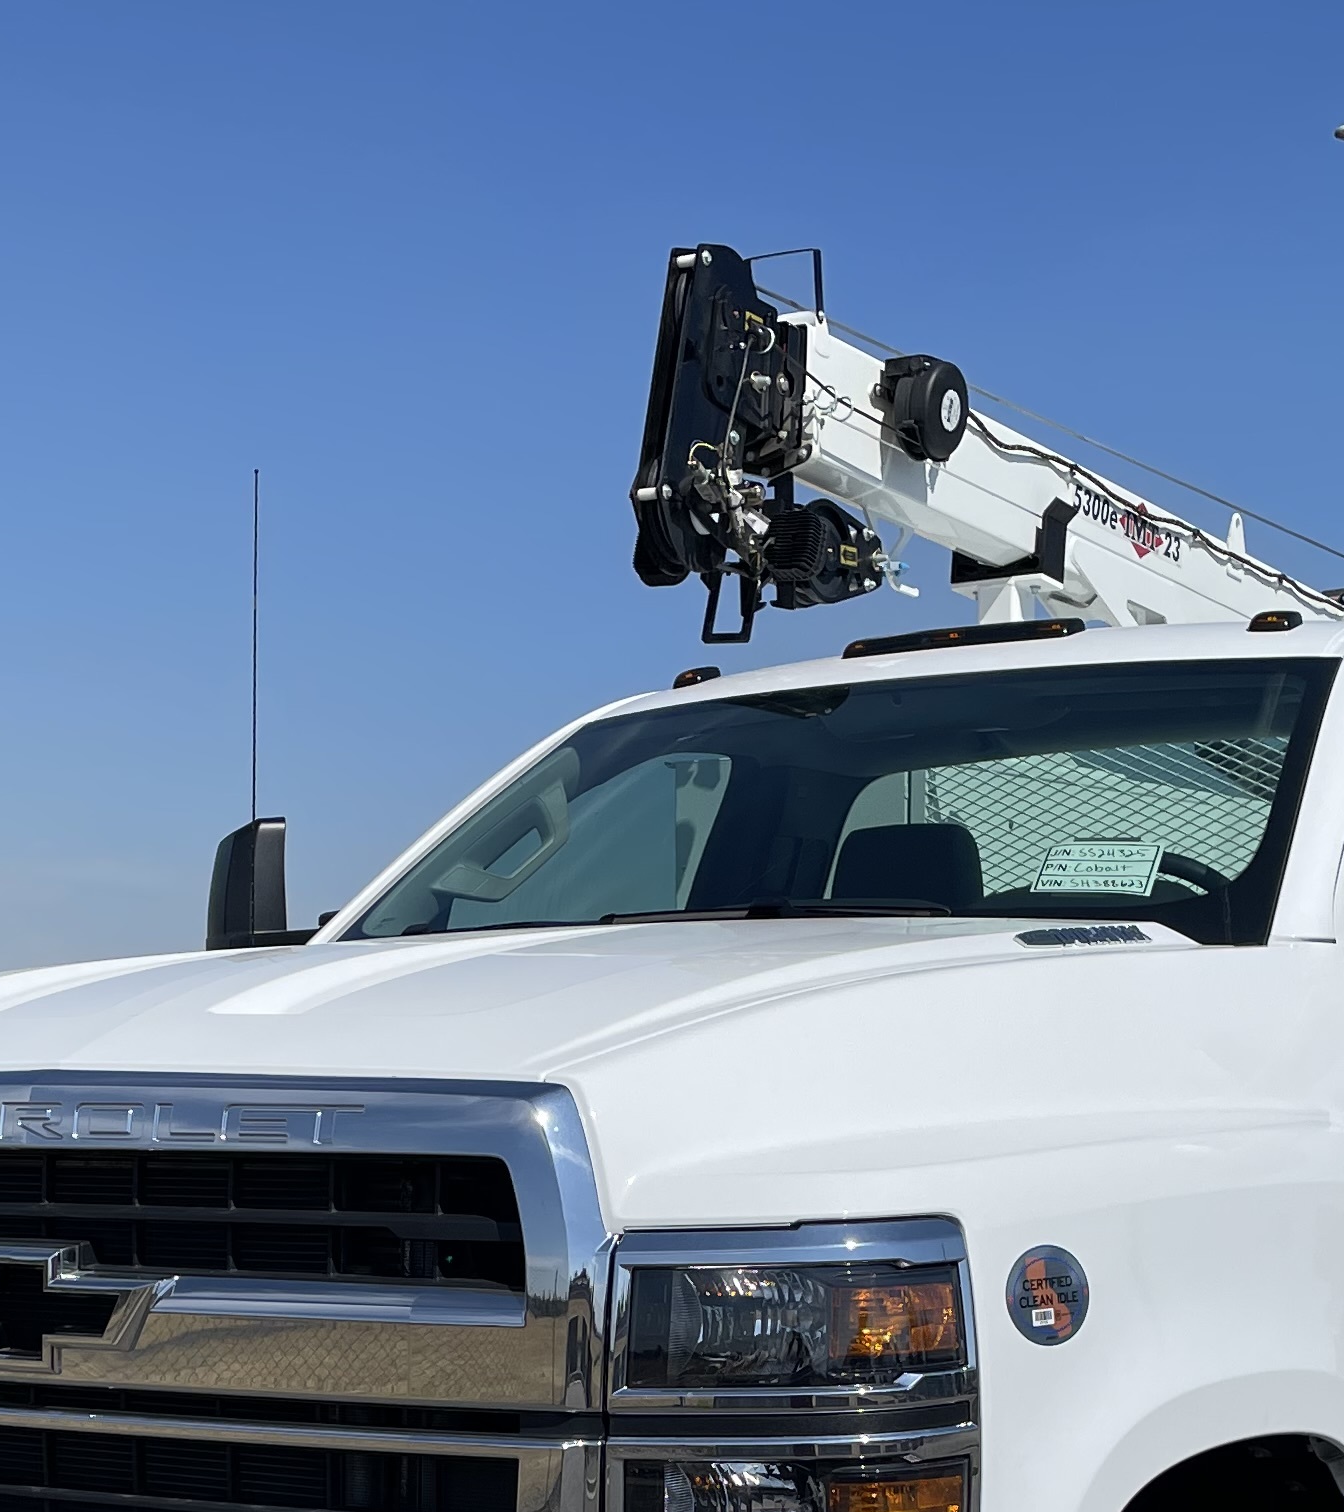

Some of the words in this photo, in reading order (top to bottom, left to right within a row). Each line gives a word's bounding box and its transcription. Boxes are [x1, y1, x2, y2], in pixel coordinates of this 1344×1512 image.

[1073, 484, 1118, 530] 5300e
[1124, 509, 1159, 552] IMT
[1163, 532, 1181, 562] 23
[1074, 862, 1133, 873] Cobalt
[1022, 1275, 1073, 1292] CERTIFIED
[1019, 1294, 1054, 1308] CLEAN
[1057, 1291, 1079, 1304] IDLE
